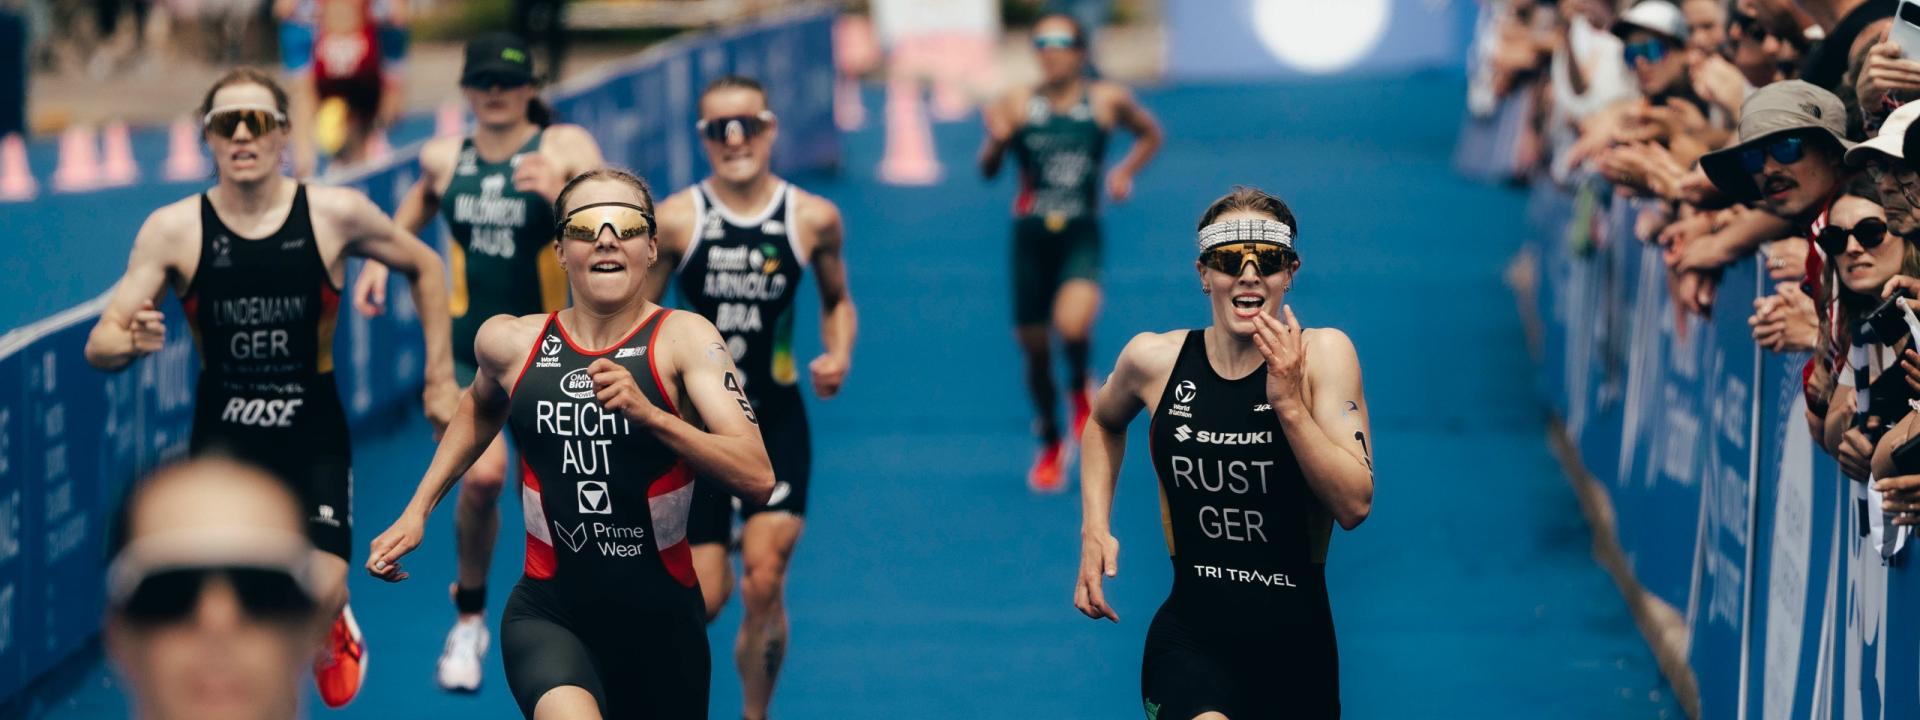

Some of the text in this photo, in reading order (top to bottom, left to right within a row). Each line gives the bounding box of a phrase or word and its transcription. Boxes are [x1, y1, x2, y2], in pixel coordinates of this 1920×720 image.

[469, 227, 516, 259] AUS
[703, 272, 787, 300] ARNOLD
[213, 296, 307, 325] LINDEMANN
[715, 303, 762, 332] BRA
[230, 329, 290, 360] GER
[221, 397, 304, 427] ROSE
[1168, 408, 1193, 419] Triathlon
[1173, 403, 1191, 412] World
[1196, 430, 1273, 445] SUZUKI
[562, 440, 612, 475] AUT
[1171, 455, 1274, 494] RUST
[593, 522, 644, 539] Prime
[1199, 505, 1268, 543] GER
[597, 541, 643, 558] Wear
[1194, 565, 1297, 588] TRI TRAVEL
